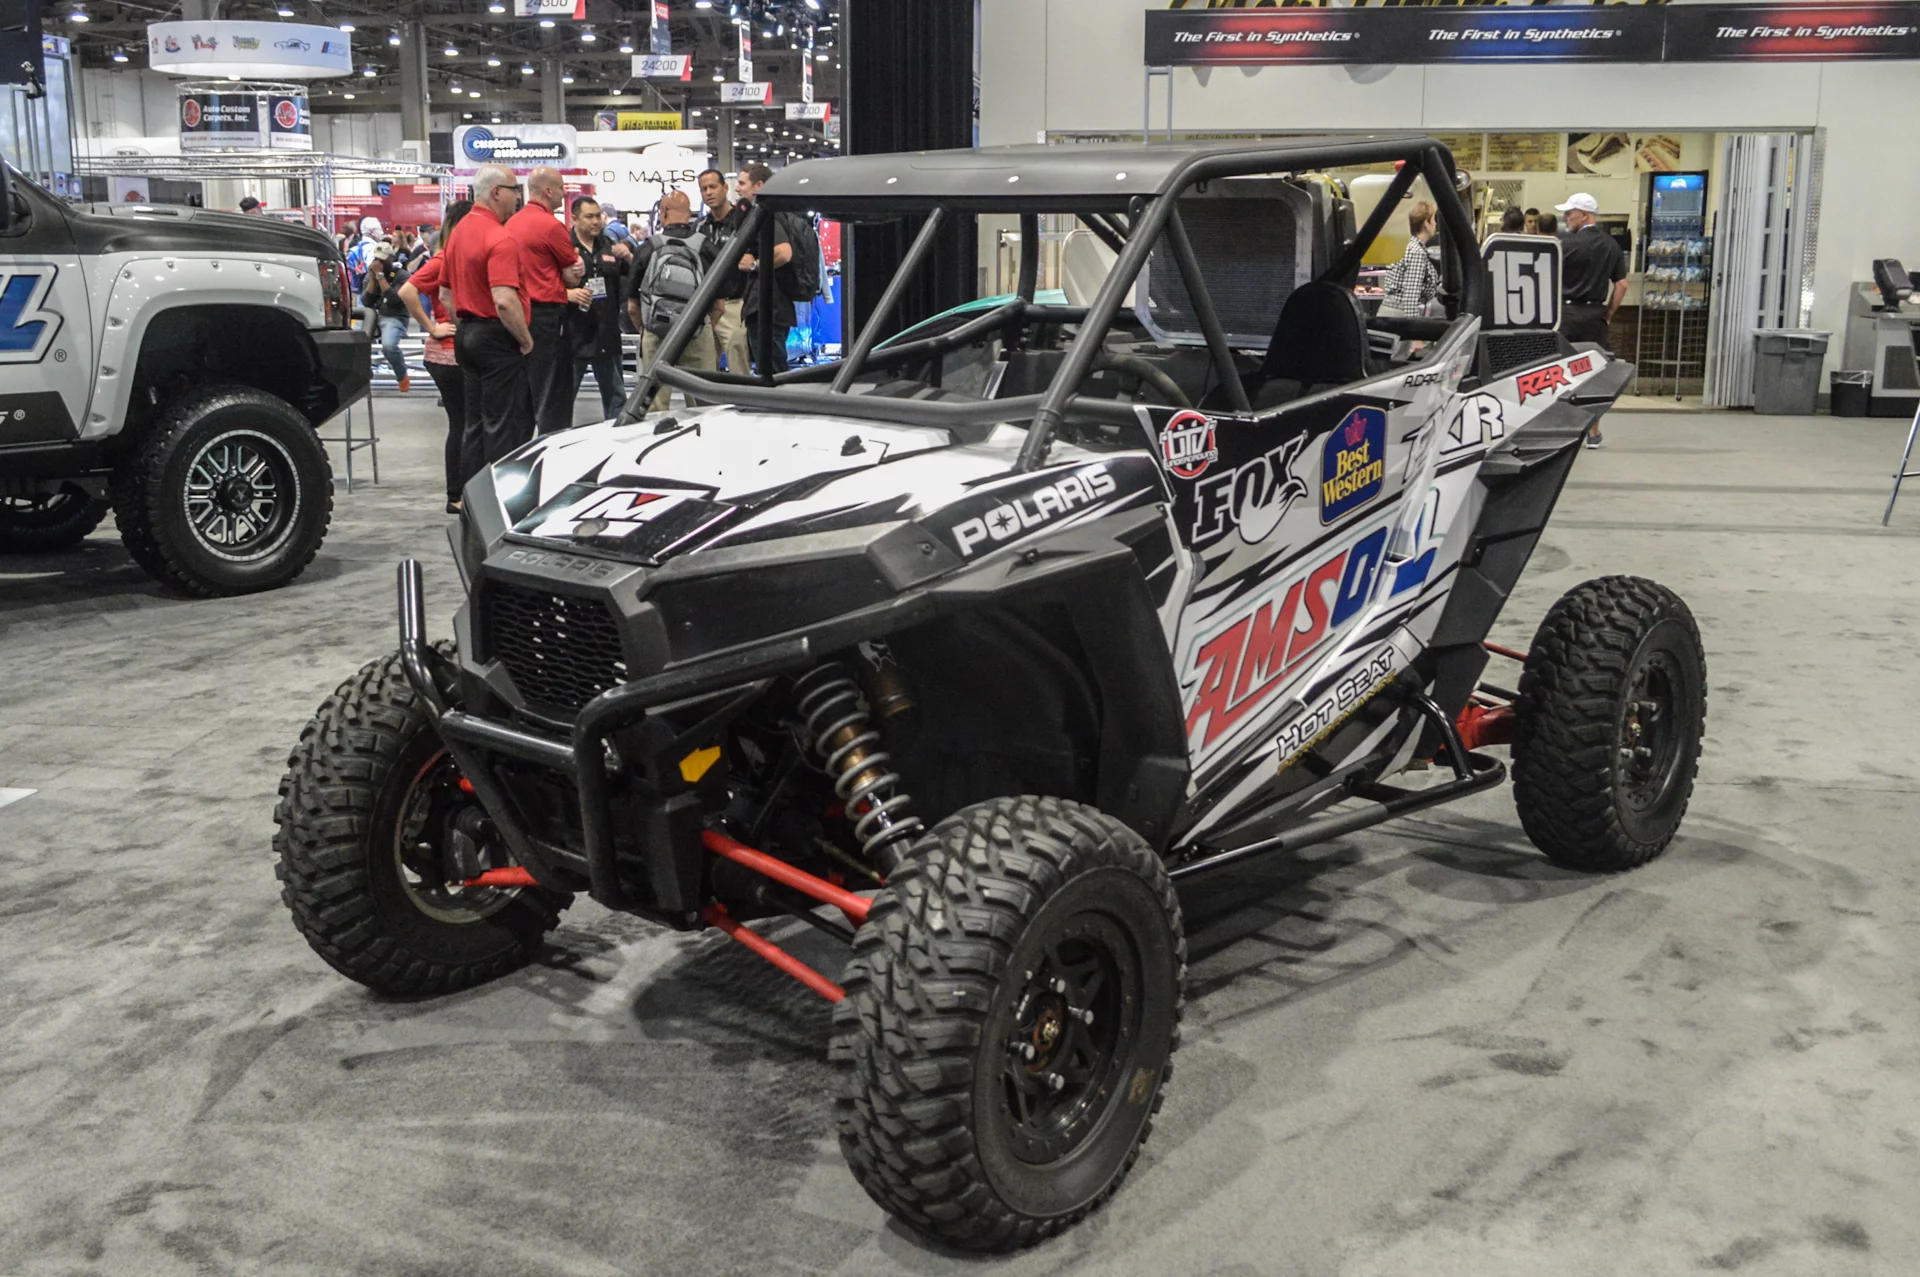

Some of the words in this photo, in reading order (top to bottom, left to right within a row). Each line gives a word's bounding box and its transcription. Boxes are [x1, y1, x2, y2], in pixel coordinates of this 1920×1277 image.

[1174, 31, 1202, 42] The
[1205, 32, 1244, 42] First
[1246, 32, 1262, 42] in
[1265, 31, 1353, 45] Synthetics
[1428, 29, 1458, 41] The
[1461, 29, 1501, 40] First
[1503, 29, 1521, 40] in
[1523, 28, 1614, 43] Synthetics
[1716, 27, 1747, 38] The
[1750, 26, 1792, 38] First
[1794, 26, 1812, 37] in
[1814, 25, 1910, 40] Synthetics
[641, 60, 677, 71] 24200
[732, 87, 761, 96] 24100
[202, 105, 219, 113] Auto
[221, 105, 251, 113] Custom
[792, 107, 821, 115] 24000
[472, 138, 518, 149] custom
[493, 145, 559, 158] autosound
[629, 169, 696, 182] MATS
[1488, 250, 1553, 326] 151
[1516, 364, 1571, 407] RZR
[1567, 355, 1592, 377] 1000
[1167, 421, 1209, 460] UTV
[1336, 436, 1370, 479] Best
[1192, 433, 1307, 545] FOX
[1323, 459, 1383, 507] Western
[951, 463, 1117, 557] POLARIS
[1187, 503, 1438, 748] AMSOL
[1277, 698, 1335, 763] HOT
[1336, 645, 1395, 711] SEAT
